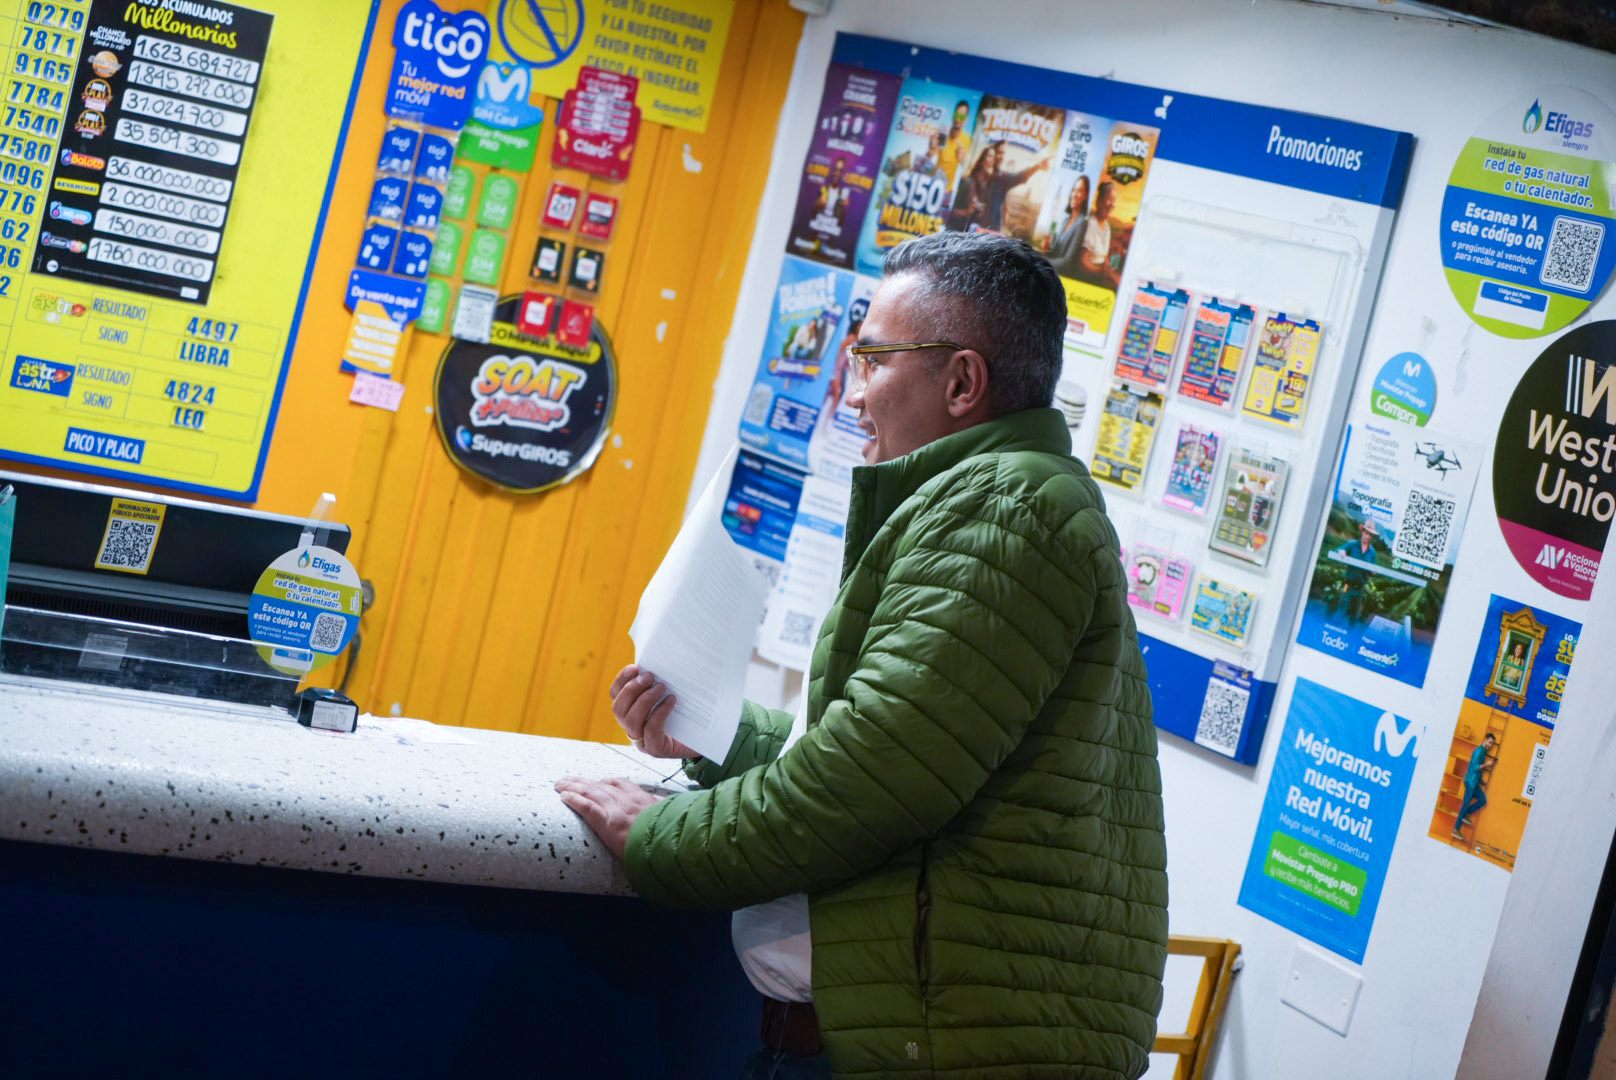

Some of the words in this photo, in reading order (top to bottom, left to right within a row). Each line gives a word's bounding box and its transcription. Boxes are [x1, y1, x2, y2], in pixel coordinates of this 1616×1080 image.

[27, 1, 85, 31] 0279
[124, 2, 238, 49] Millonarios
[21, 26, 76, 58] 7871
[16, 53, 72, 84] 9165
[402, 60, 417, 77] Tu
[11, 81, 65, 113] 7784
[394, 88, 430, 107] móvil
[398, 74, 440, 94] mejor
[440, 84, 466, 100] red
[5, 106, 59, 138] 7540
[981, 107, 1055, 147] TRILOTO
[1545, 111, 1594, 139] Efigas
[1111, 133, 1150, 159] GIROS
[1266, 124, 1363, 172] Promociones
[1488, 143, 1517, 160] Instala
[1517, 151, 1527, 160] tu
[1484, 156, 1506, 172] red
[1507, 160, 1521, 175] de
[1523, 165, 1544, 181] gas
[1546, 169, 1590, 188] natural
[1504, 181, 1512, 192] o
[1514, 180, 1527, 195] tu
[1528, 183, 1594, 209] calentador.
[1465, 202, 1518, 225] Escanea
[1521, 215, 1538, 231] YA
[1451, 219, 1478, 237] este
[1480, 223, 1522, 248] código
[1525, 233, 1544, 251] QR
[1455, 251, 1471, 262] para
[1472, 253, 1496, 268] recibir
[1496, 249, 1504, 258] al
[1504, 251, 1537, 266] vendedor
[93, 297, 147, 322] RESULTADO
[98, 325, 129, 345] SIGNO
[186, 316, 240, 343] 4497
[179, 341, 231, 368] LIBRA
[77, 362, 131, 386] RESULTADO
[477, 360, 580, 402] SOAT
[82, 390, 113, 409] SIGNO
[165, 379, 216, 405] 4824
[174, 407, 205, 429] LEO
[68, 431, 94, 453] PICO
[97, 436, 106, 454] Y
[104, 437, 140, 461] PLACA
[1528, 408, 1616, 475] West
[1352, 488, 1392, 509] Topografía
[312, 557, 341, 574] Efigas
[273, 578, 287, 588] red
[288, 581, 298, 590] de
[299, 584, 312, 595] gas
[313, 586, 340, 600] natural
[292, 592, 300, 601] tu
[301, 594, 342, 610] calentador.
[253, 611, 272, 622] este
[272, 614, 299, 630] código
[299, 621, 312, 631] QR
[262, 602, 296, 617] Escanea
[296, 609, 308, 620] YA
[1295, 728, 1393, 788] Mejoramos
[1303, 767, 1372, 810] nuestra
[1285, 785, 1323, 819] Red
[1322, 801, 1374, 844] Móvil.
[1271, 848, 1307, 873] Movistar
[1305, 864, 1340, 889] Prepago
[1339, 879, 1359, 897] PRO
